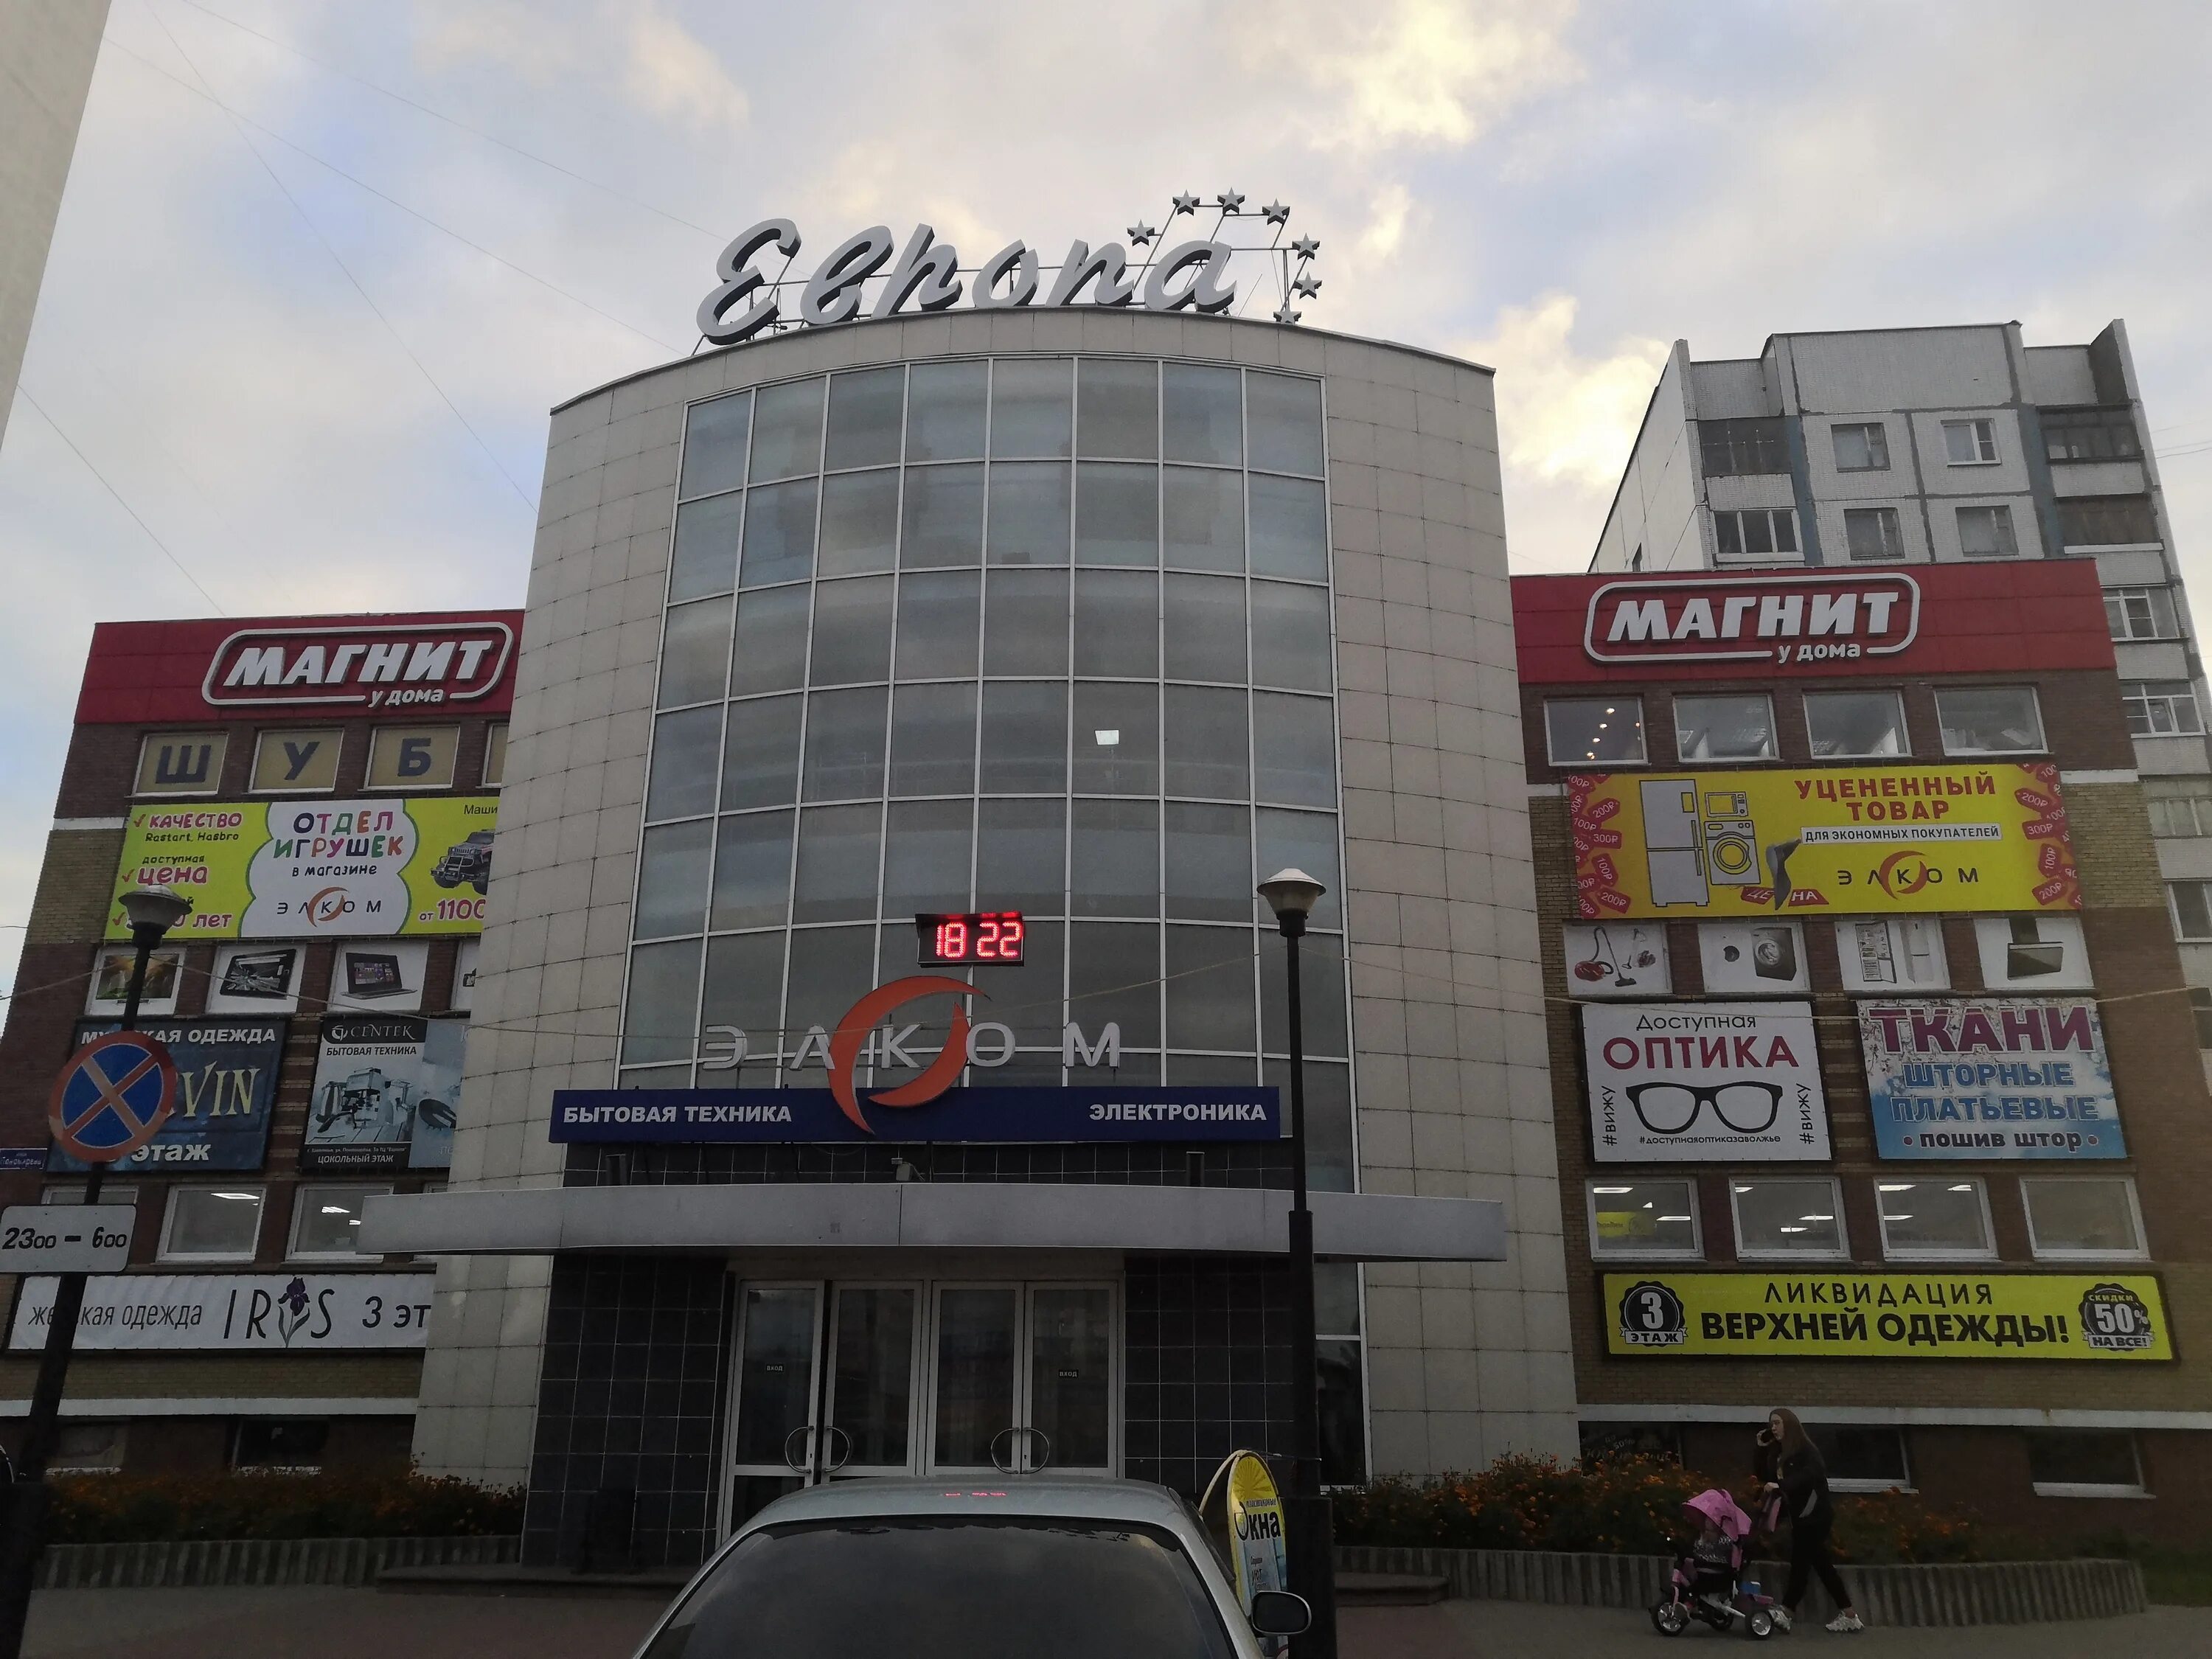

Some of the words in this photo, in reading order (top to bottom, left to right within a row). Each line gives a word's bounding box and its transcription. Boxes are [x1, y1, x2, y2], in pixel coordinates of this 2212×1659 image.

[695, 217, 1239, 346] Европа
[1607, 592, 1899, 641] МАГНИТ
[223, 640, 493, 686] МАГНИТ
[1778, 644, 1790, 664] у
[1797, 642, 1861, 661] дома
[367, 689, 383, 708] у
[385, 688, 445, 706] дома
[1795, 771, 1996, 802] УЦЕНЕННЫЙ
[464, 804, 498, 815] Маши
[1846, 801, 1950, 821] ТОВАР
[150, 813, 242, 828] КАЧЕСТВО
[293, 810, 393, 835] ОТДЕЛ
[198, 832, 239, 841] Hasbro
[1806, 831, 1829, 842] ДЛЯ
[1832, 830, 1908, 840] ЭКОНОМНЫХ
[1912, 826, 2000, 838] ПОКУПАТЕЛЕЙ
[273, 835, 403, 858] ИГРУШЕК
[142, 855, 205, 864] доступная
[137, 866, 208, 886] цена
[305, 864, 378, 877] магазине
[192, 914, 232, 928] лет
[420, 913, 434, 921] от
[351, 1024, 416, 1040] CENTEK
[1636, 1015, 1756, 1032] Доступная
[1868, 1006, 2094, 1053] ТКАНИ
[187, 1029, 276, 1044] ОДЕЖДА
[327, 1047, 372, 1056] БЫТОВАЯ
[375, 1046, 417, 1055] ТЕХНИКА
[1603, 1035, 1799, 1070] ОПТИКА
[1902, 1062, 2076, 1088] ШТОРНЫЕ
[563, 1107, 676, 1123] БЫТОВАЯ
[684, 1106, 792, 1122] ТЕХНИКА
[1089, 1104, 1267, 1121] ЭЛЕКТРОНИКА
[1601, 1085, 1617, 1146] #вижу
[1796, 1083, 1814, 1144] #вижу
[1891, 1096, 2099, 1121] ПЛАТЬЕВЫЕ
[1639, 1135, 1781, 1145] #доступнаяоптиказаволжье
[1920, 1133, 2006, 1147] пошив
[2014, 1133, 2081, 1152] штор
[131, 1144, 211, 1162] этаж
[318, 1154, 369, 1164] ЦОКОЛЬНЫЙ
[372, 1155, 394, 1163] ЭТАЖ
[1765, 1283, 1992, 1308] ЛИКВИДАЦИЯ
[28, 1307, 115, 1326] жекая
[122, 1305, 202, 1329] одежда
[362, 1295, 383, 1328] 3
[393, 1304, 431, 1328] эт
[1641, 1292, 1663, 1329] 3
[1701, 1307, 1868, 1340] ВЕРХНЕЙ
[1877, 1313, 2070, 1347] ОДЕЖДЫ!
[1630, 1332, 1680, 1343] ЭТАЖ
[2093, 1337, 2114, 1346] НА
